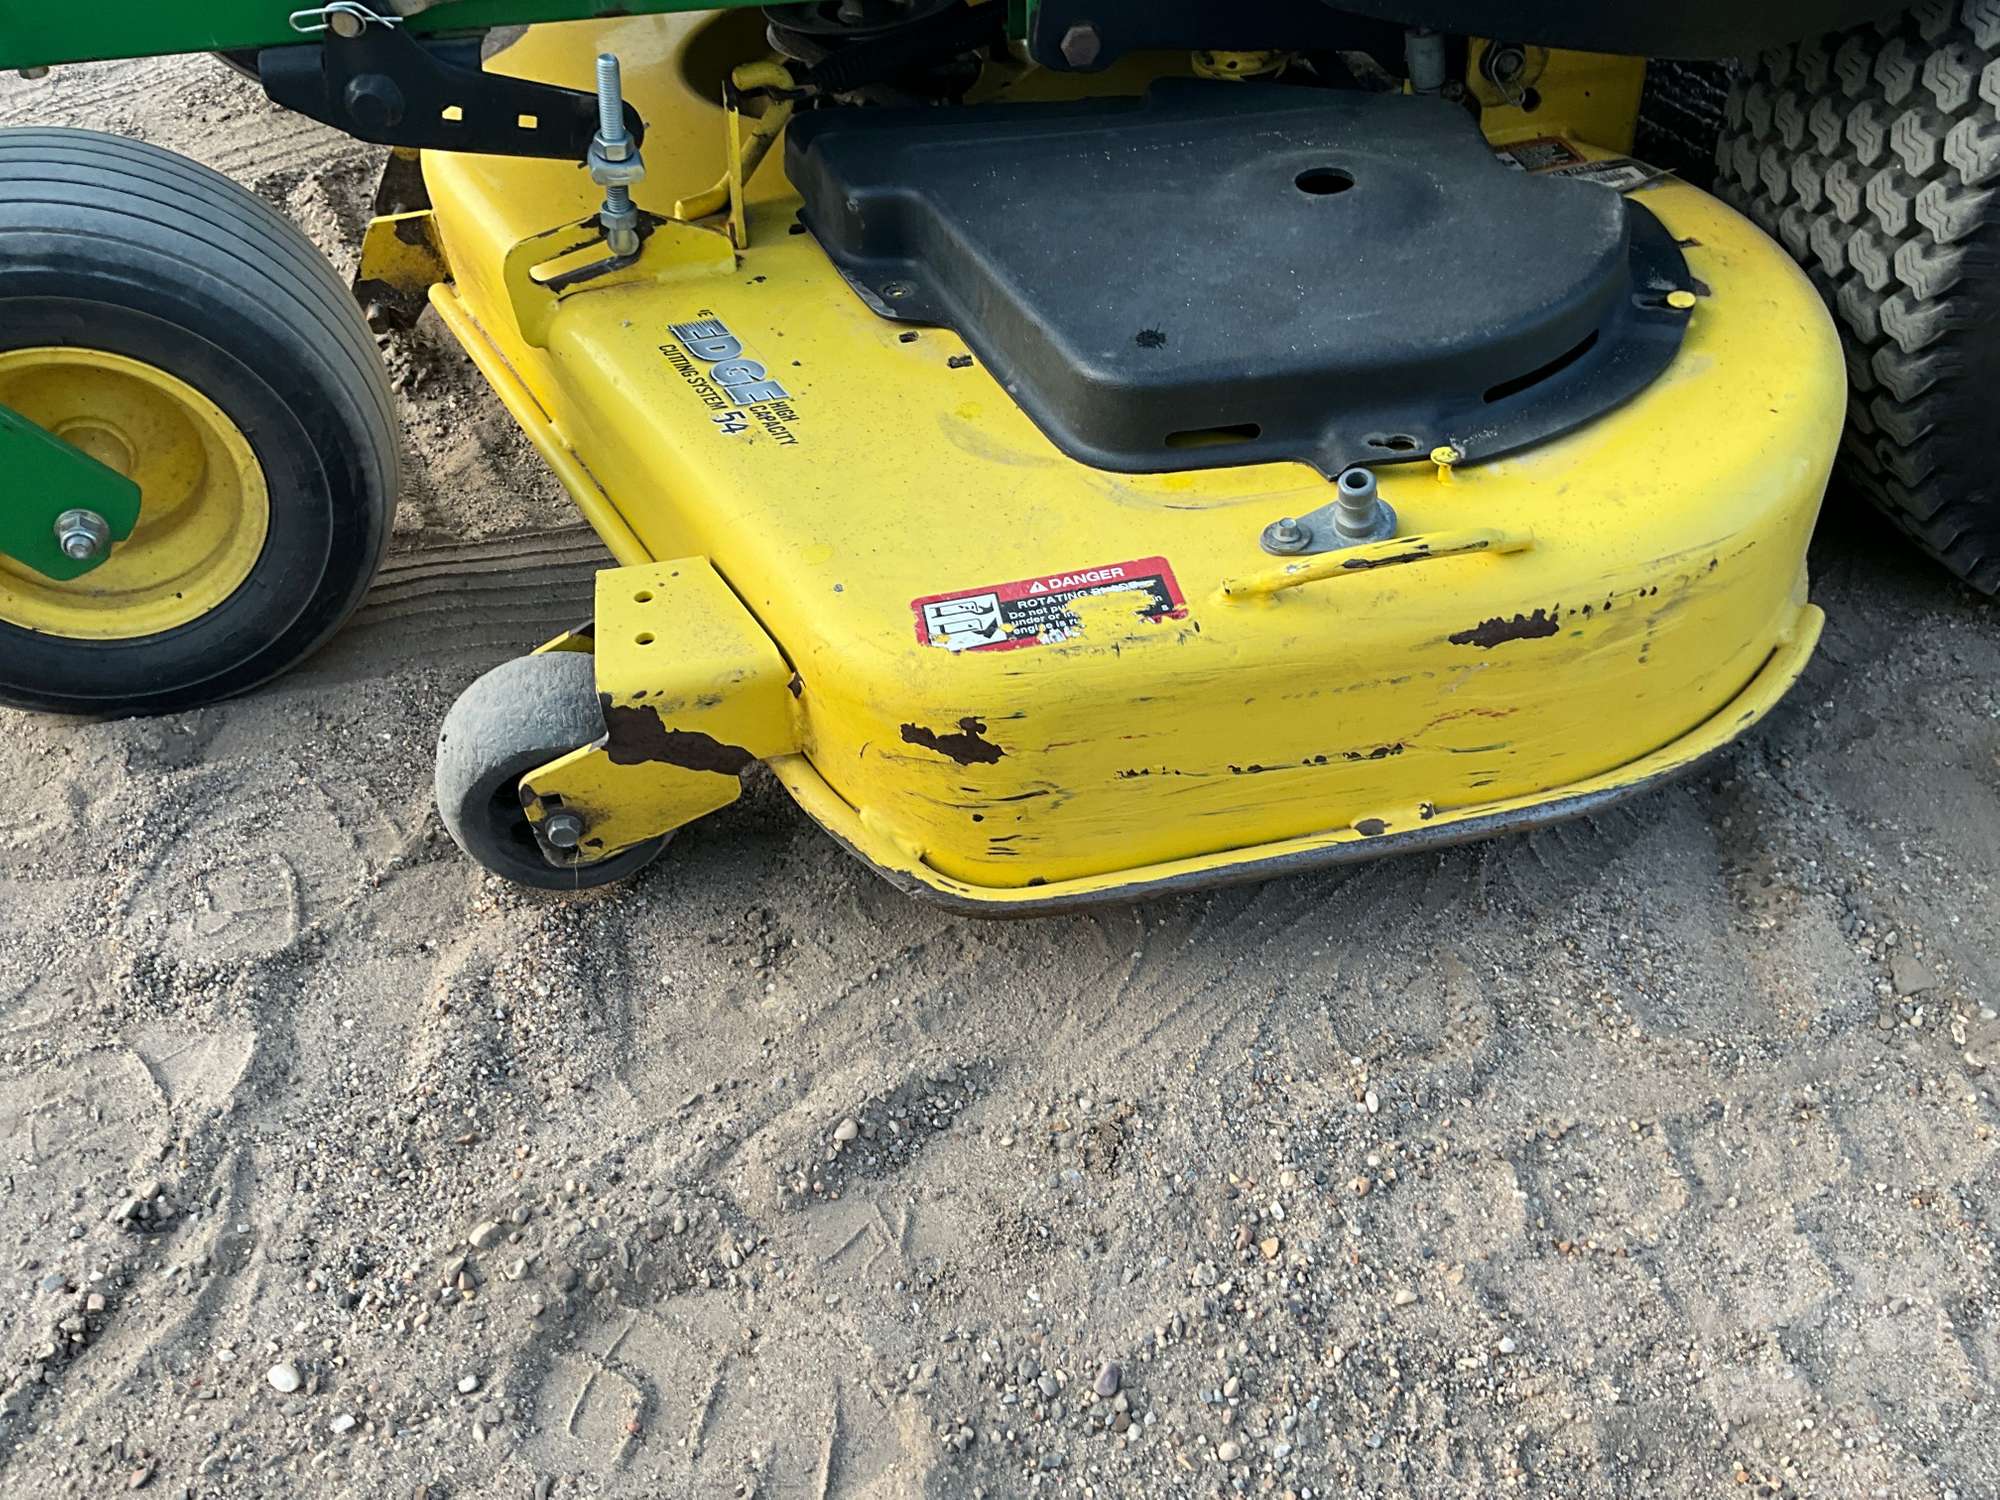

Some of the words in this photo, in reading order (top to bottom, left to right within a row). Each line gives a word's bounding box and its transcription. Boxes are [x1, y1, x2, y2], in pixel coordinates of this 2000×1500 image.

[667, 319, 789, 406] EDGE
[659, 343, 698, 378] CUTTING
[687, 374, 729, 411] SYSTEM
[768, 399, 800, 422] HIGH
[711, 410, 749, 434] 54
[748, 403, 799, 446] CAPACITY
[1049, 567, 1125, 589] DANGER
[1017, 590, 1088, 609] ROTATING
[1008, 611, 1026, 619] Do
[1028, 607, 1048, 616] not
[1011, 615, 1046, 627] under
[1047, 613, 1060, 621] or
[1013, 623, 1053, 636] engie
[1056, 620, 1067, 628] is
